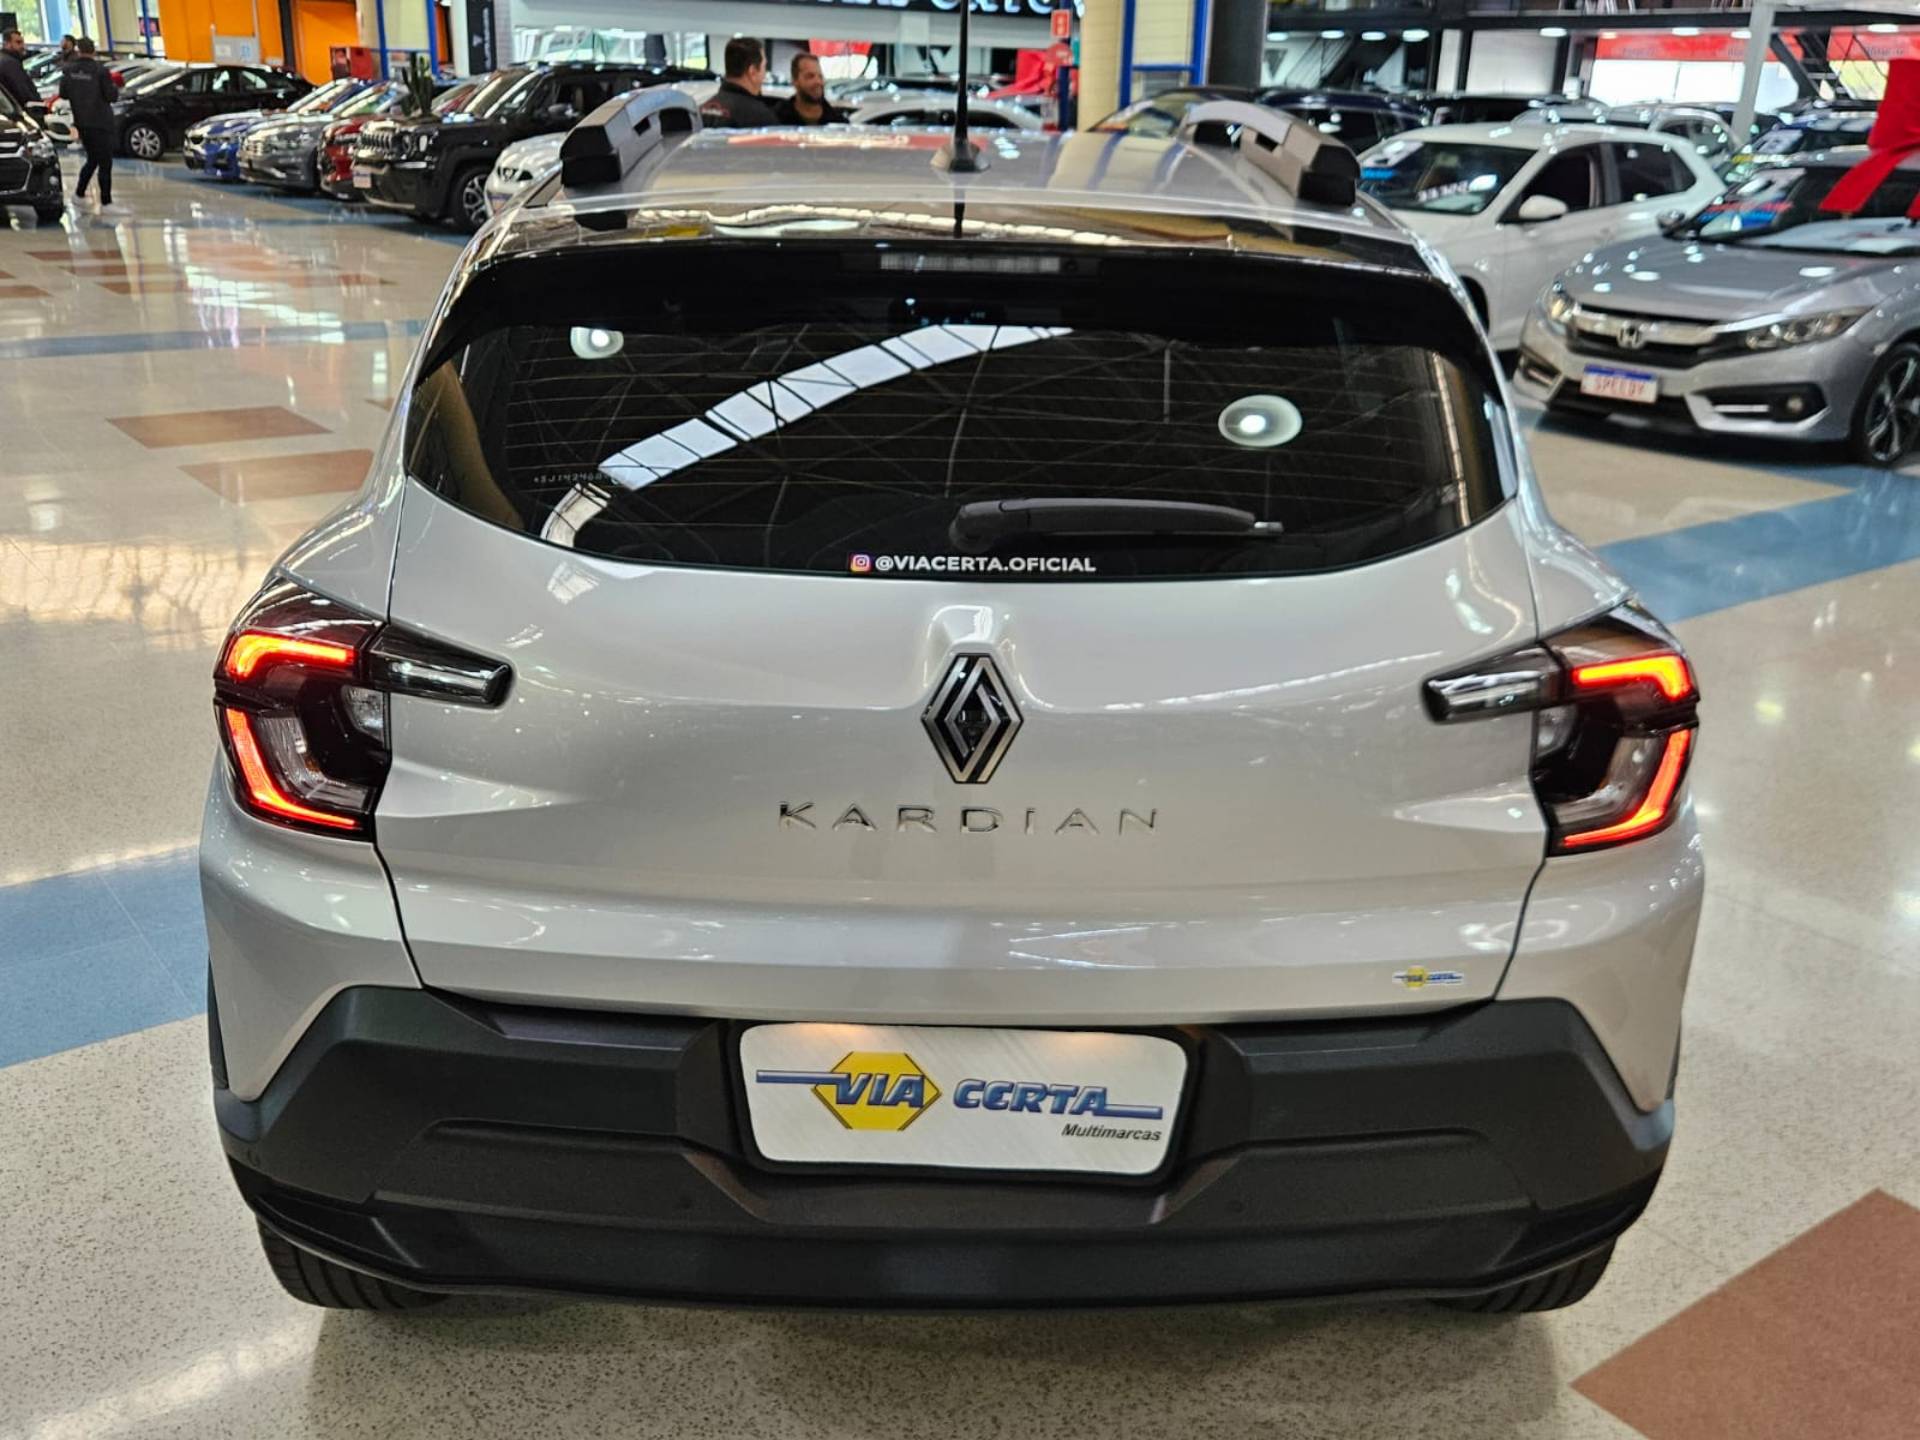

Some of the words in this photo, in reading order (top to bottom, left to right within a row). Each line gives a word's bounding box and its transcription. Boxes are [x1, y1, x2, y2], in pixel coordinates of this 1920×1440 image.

[875, 555, 1097, 572] @VIACERTA.OFICIAL
[778, 802, 1158, 835] KARDIAN
[834, 1073, 925, 1108] VIA
[1061, 1123, 1163, 1141] Multimarcas
